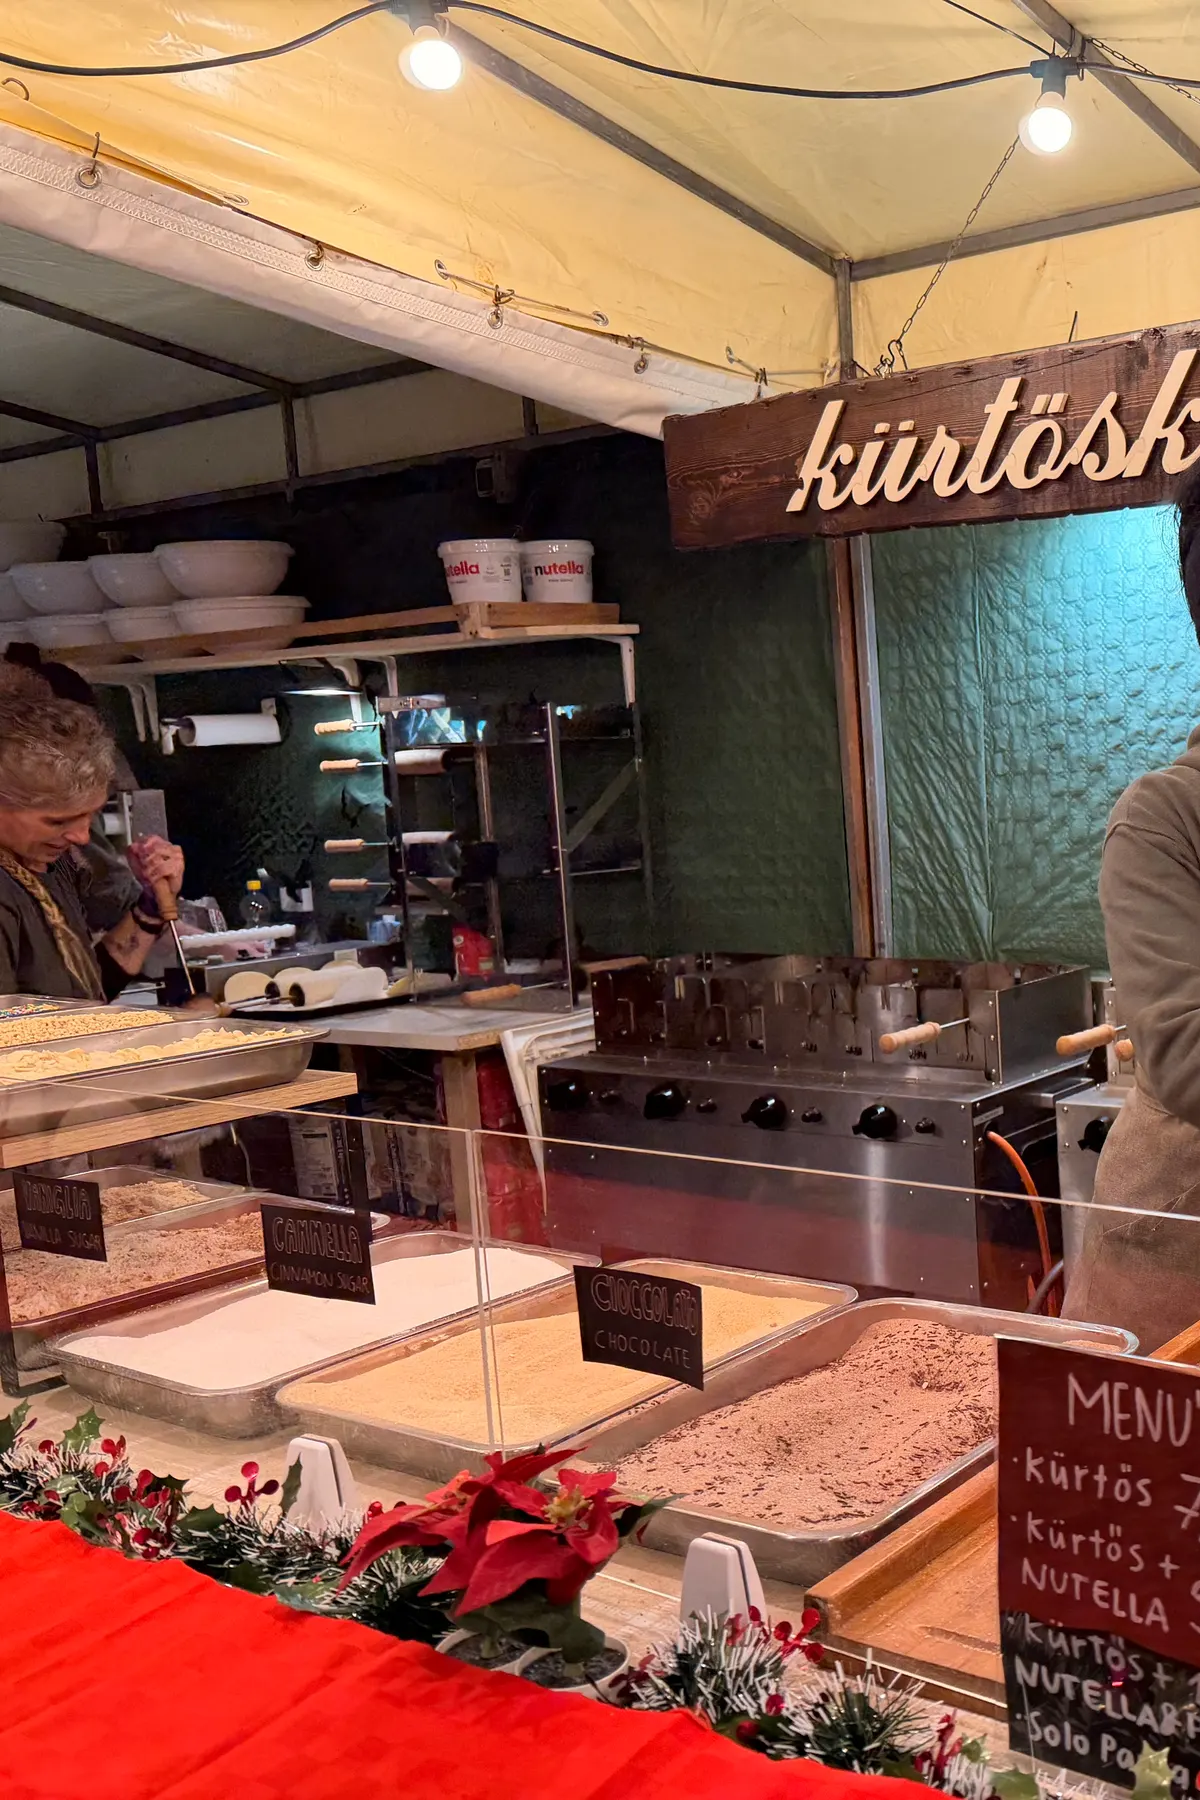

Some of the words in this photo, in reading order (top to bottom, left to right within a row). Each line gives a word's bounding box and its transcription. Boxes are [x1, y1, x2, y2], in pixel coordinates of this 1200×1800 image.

[534, 561, 584, 576] nutella
[273, 1217, 363, 1264] CANNELLA
[270, 1261, 334, 1288] CINNAMON
[337, 1272, 370, 1294] SUGAR
[591, 1274, 698, 1336] CIOCCOLATO
[594, 1330, 691, 1369] CHOCOLATE
[1021, 1557, 1169, 1633] NUTELLA
[1029, 1710, 1091, 1756] Solo
